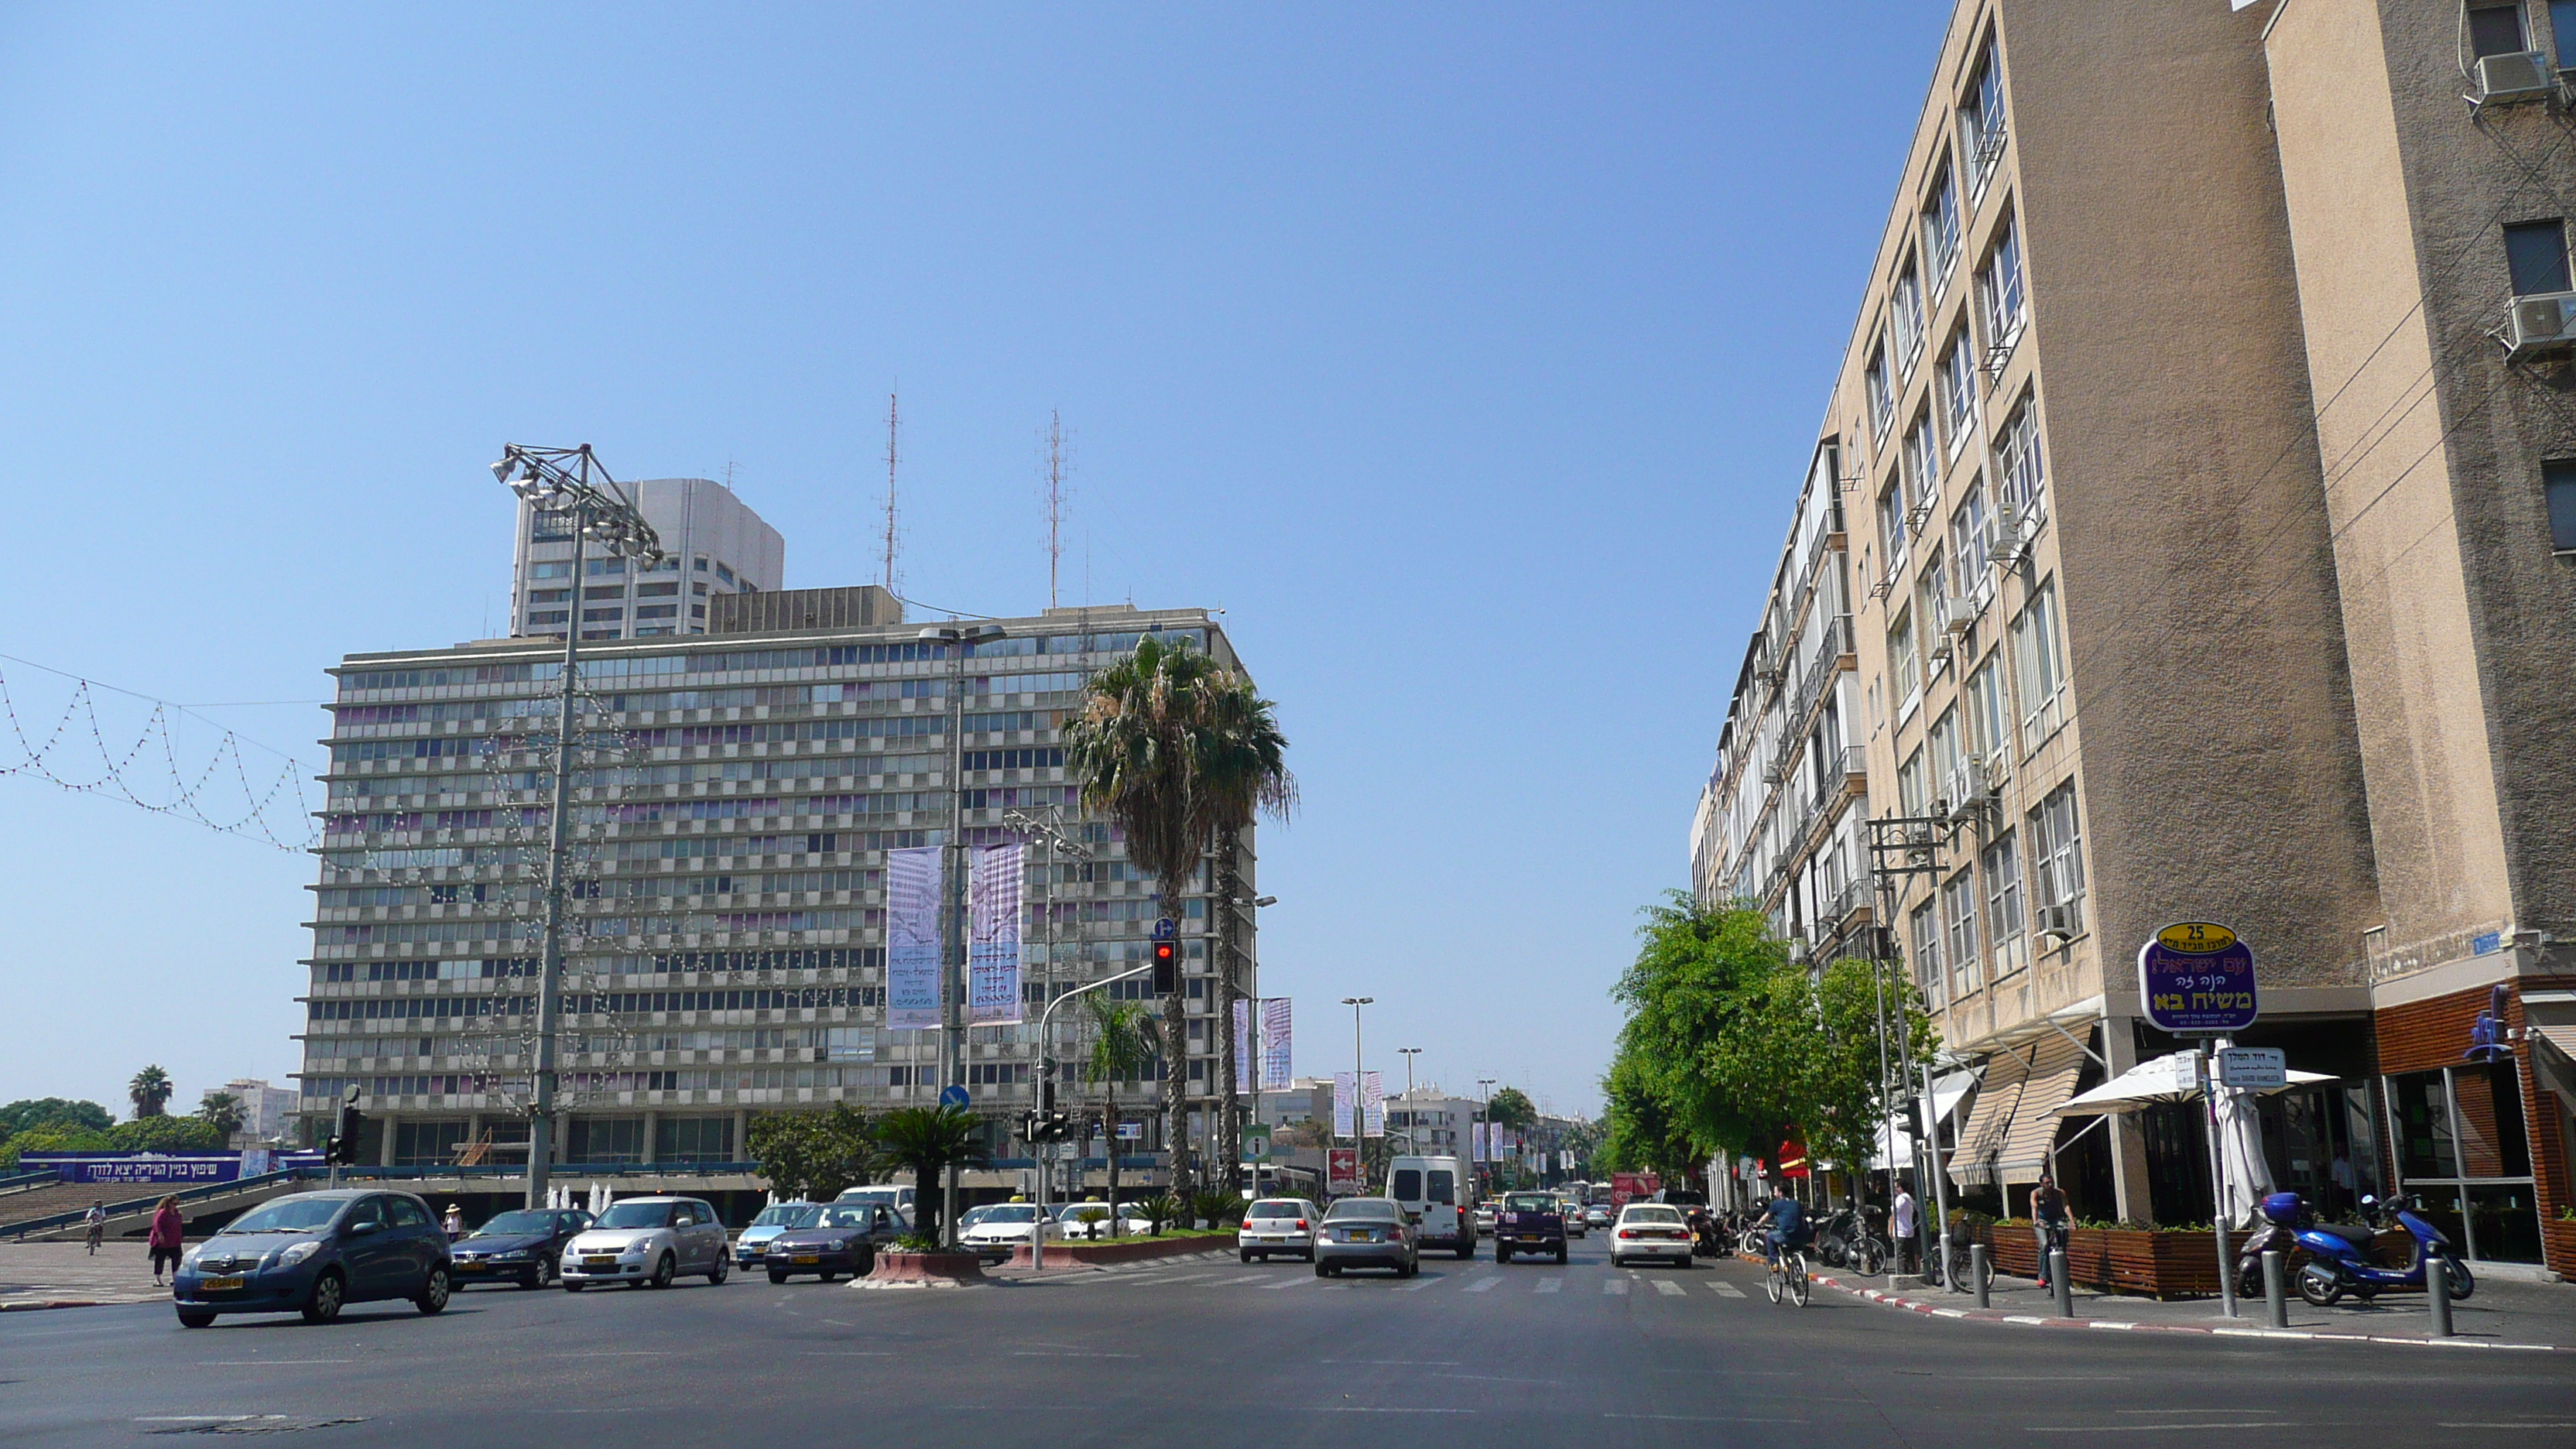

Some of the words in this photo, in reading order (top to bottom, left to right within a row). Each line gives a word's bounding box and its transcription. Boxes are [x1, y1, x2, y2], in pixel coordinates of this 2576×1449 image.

[2187, 925, 2204, 940] 25
[2223, 957, 2248, 976] עם
[2175, 975, 2194, 990] זה
[2199, 974, 2226, 992] הנה
[2153, 992, 2185, 1011] בא
[2191, 992, 2252, 1010] משיח
[2228, 1051, 2249, 1063] המלך
[2252, 1053, 2266, 1061] דוד
[115, 1163, 132, 1176] יצא
[135, 1163, 166, 1176] העירייה
[169, 1163, 188, 1178] בניין
[190, 1163, 218, 1178] שיפוץ
